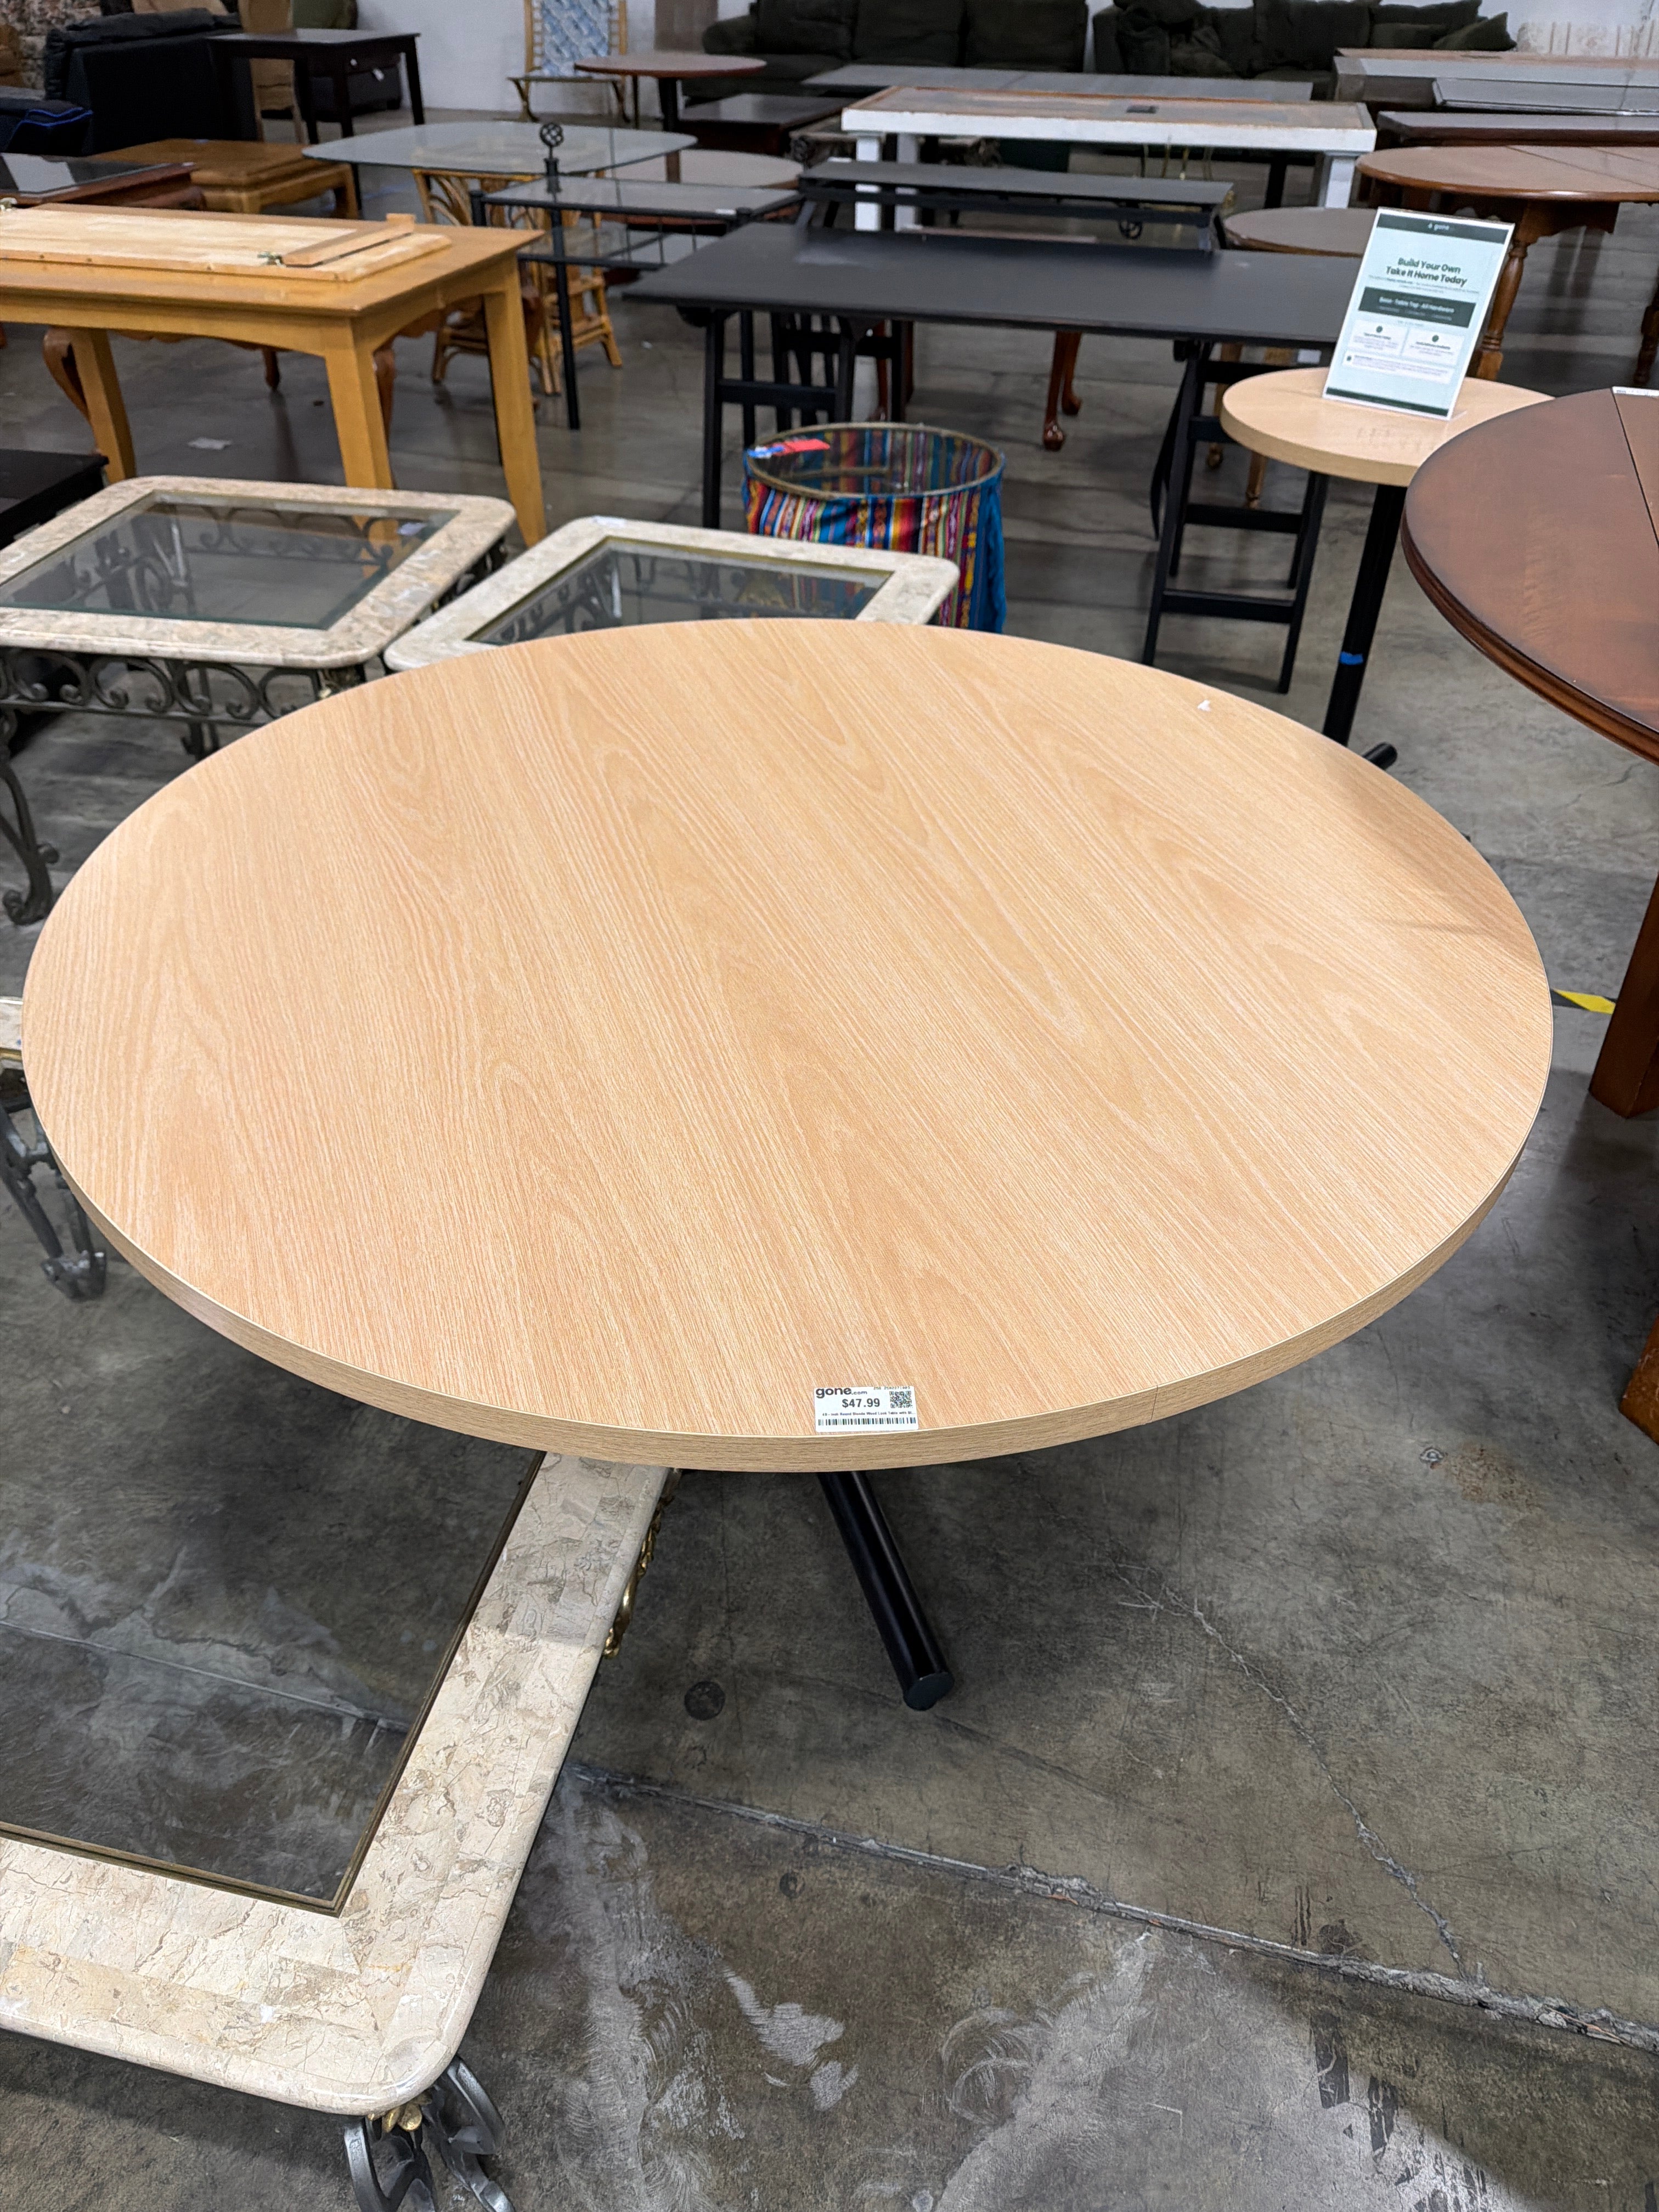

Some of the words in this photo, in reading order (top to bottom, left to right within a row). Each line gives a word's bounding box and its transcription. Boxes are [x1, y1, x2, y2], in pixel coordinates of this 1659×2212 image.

[1398, 257, 1420, 268] Build
[1421, 261, 1441, 270] Your
[1441, 264, 1461, 274] Own
[1386, 266, 1406, 275] Take
[1407, 268, 1413, 277] It
[1414, 270, 1439, 281] Home
[1441, 274, 1468, 287] Today
[815, 1387, 868, 1399] gone.com
[842, 1398, 881, 1409] $47.99
